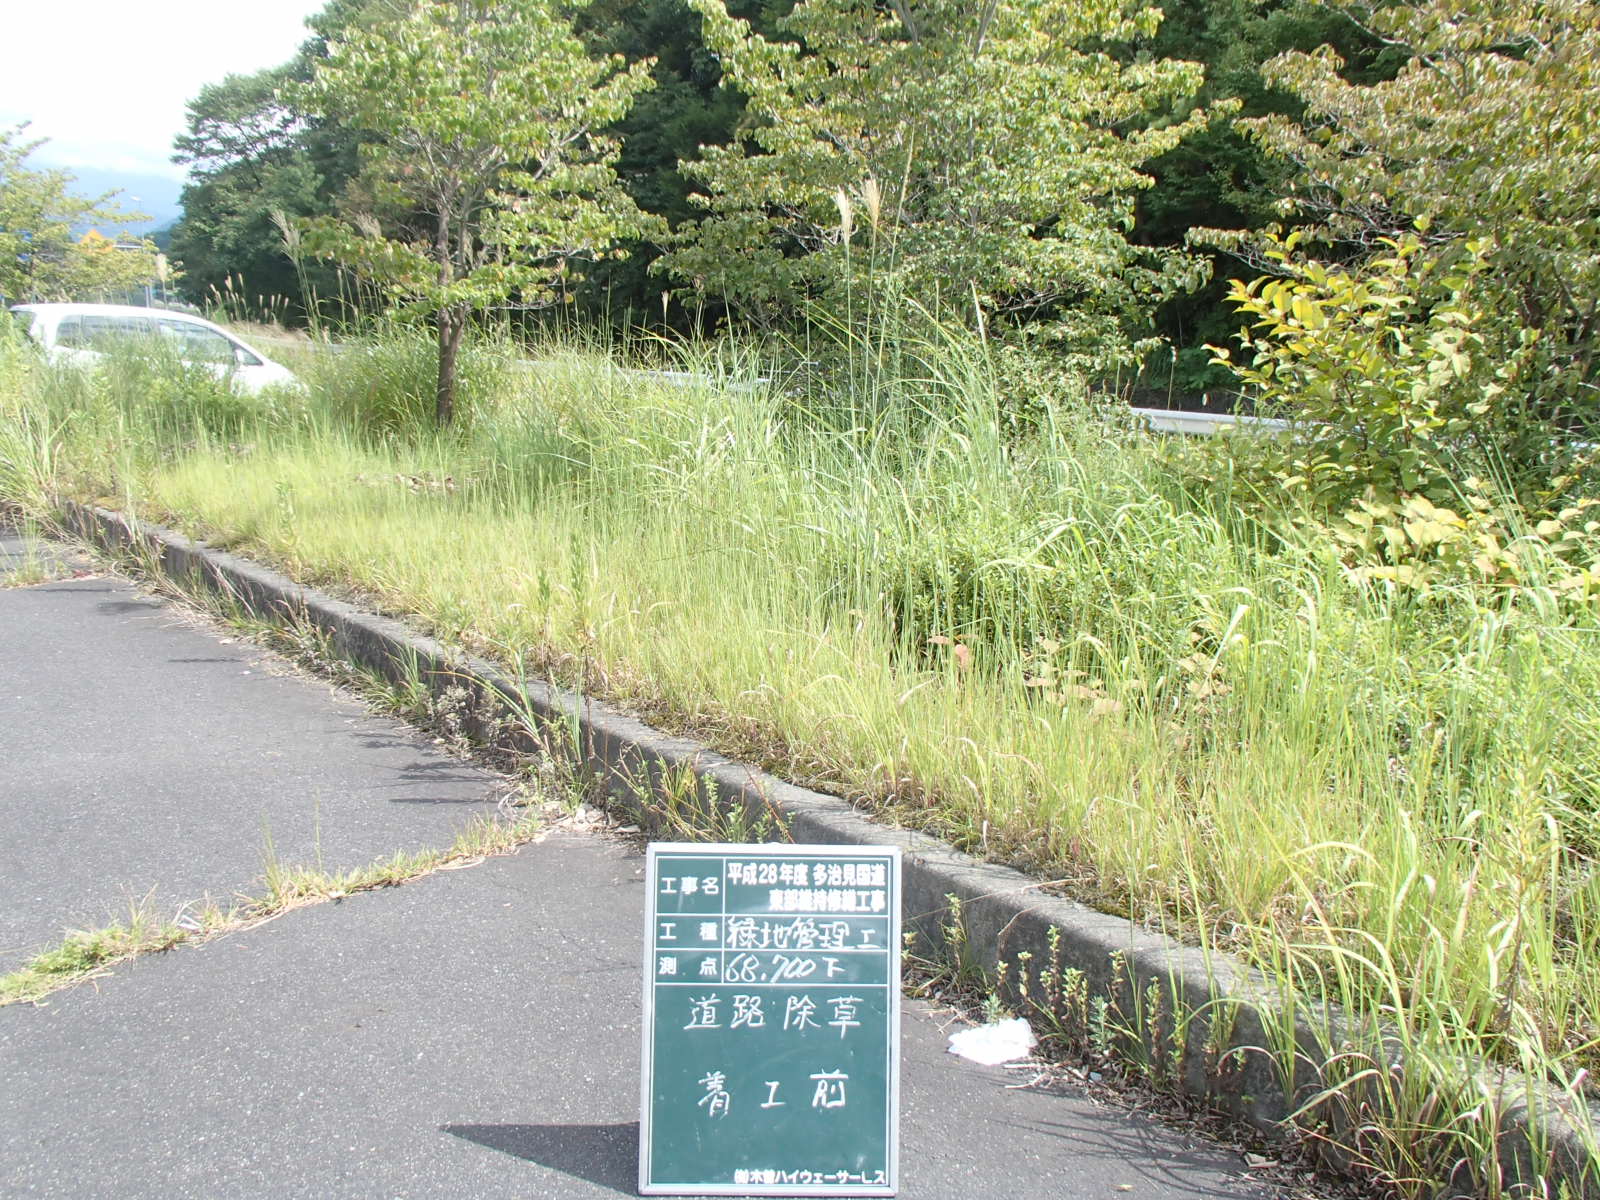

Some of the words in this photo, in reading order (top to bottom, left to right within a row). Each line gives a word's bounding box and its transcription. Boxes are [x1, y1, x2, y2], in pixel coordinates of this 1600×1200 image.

[727, 862, 808, 886] 平成28年度
[813, 863, 886, 886] 多治見国道
[660, 877, 719, 894] 工事名
